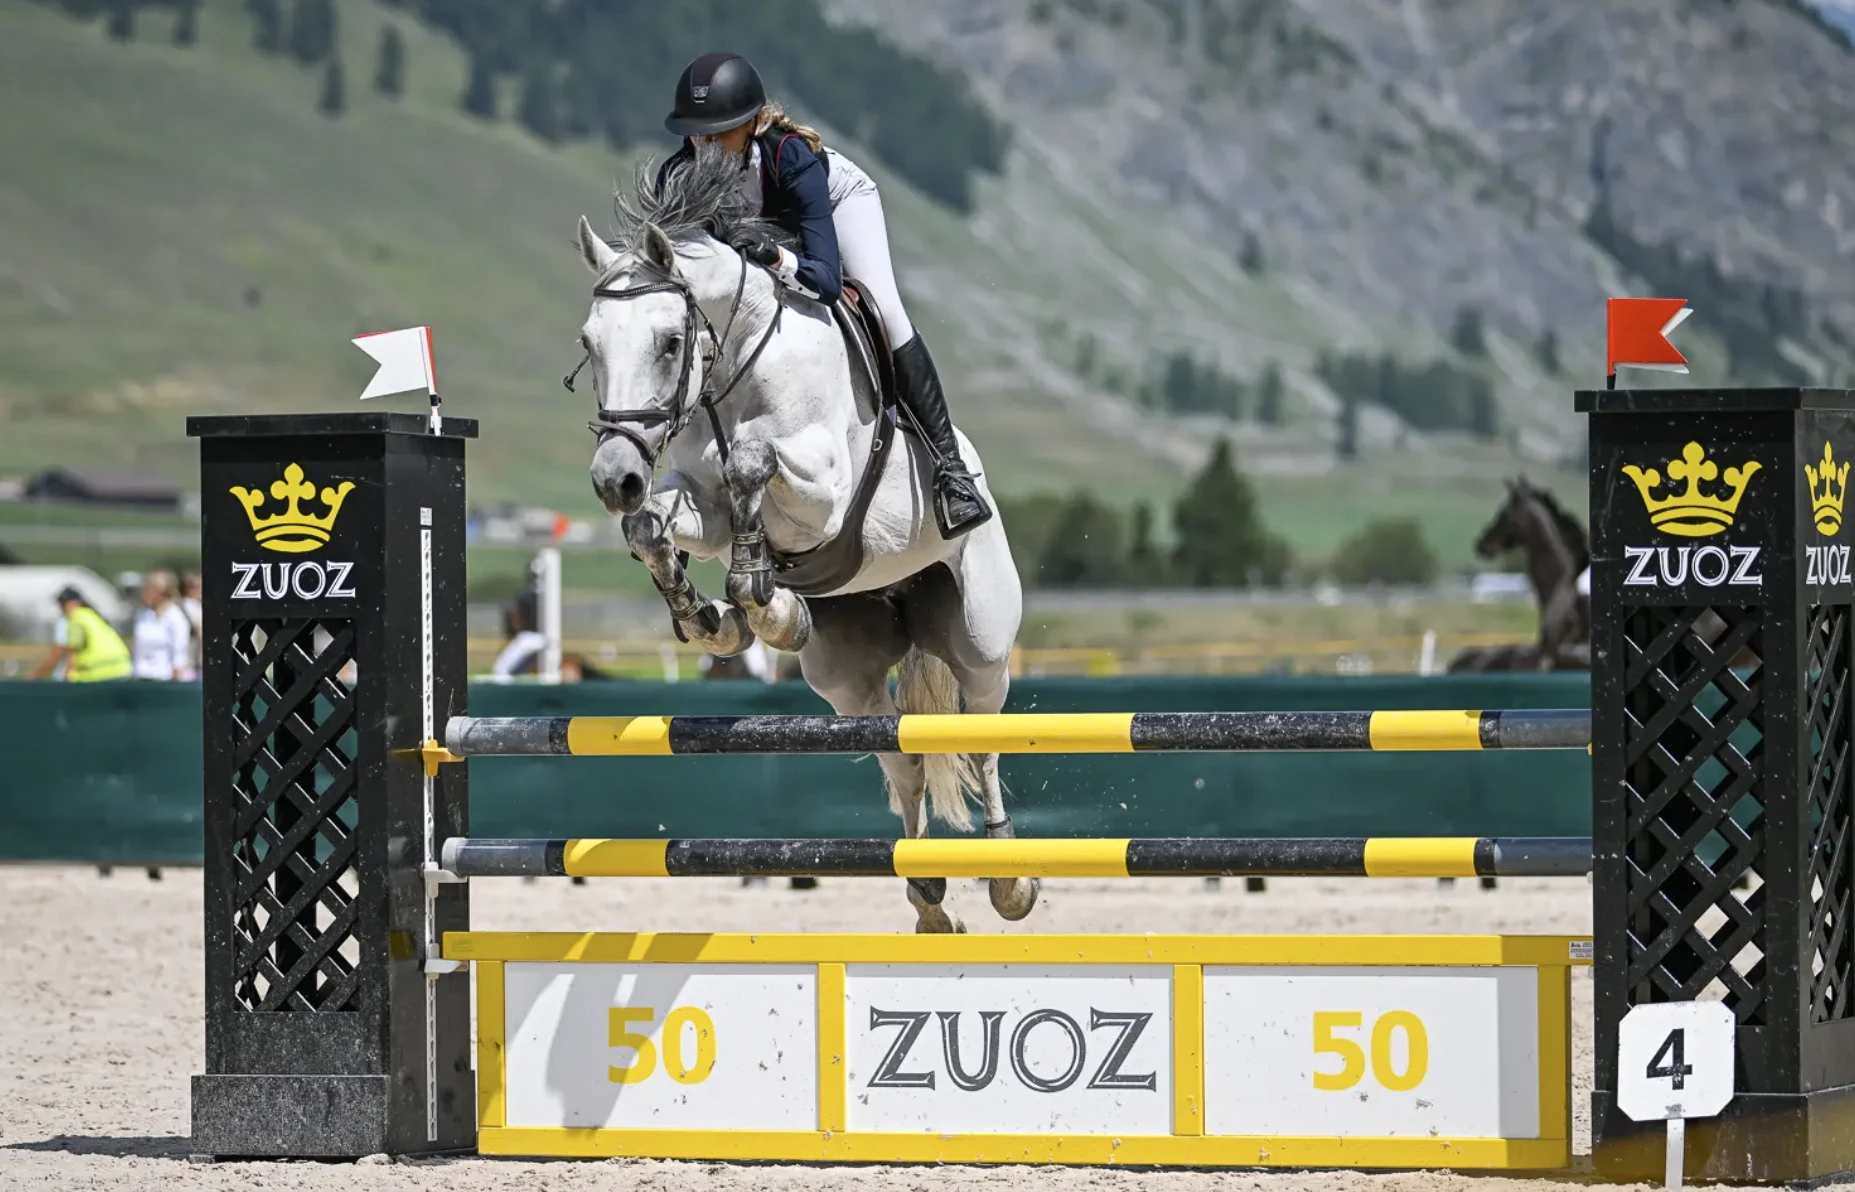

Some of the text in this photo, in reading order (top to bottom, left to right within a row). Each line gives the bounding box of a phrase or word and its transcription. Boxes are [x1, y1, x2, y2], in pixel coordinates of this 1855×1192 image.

[231, 560, 355, 600] ZUOZ
[1623, 545, 1763, 587] ZUOZ
[1805, 544, 1852, 586] ZUOZ
[608, 1007, 716, 1085] 50
[868, 1006, 1157, 1092] ZUOZ
[1313, 1011, 1428, 1091] 50
[1647, 1029, 1693, 1091] 4
